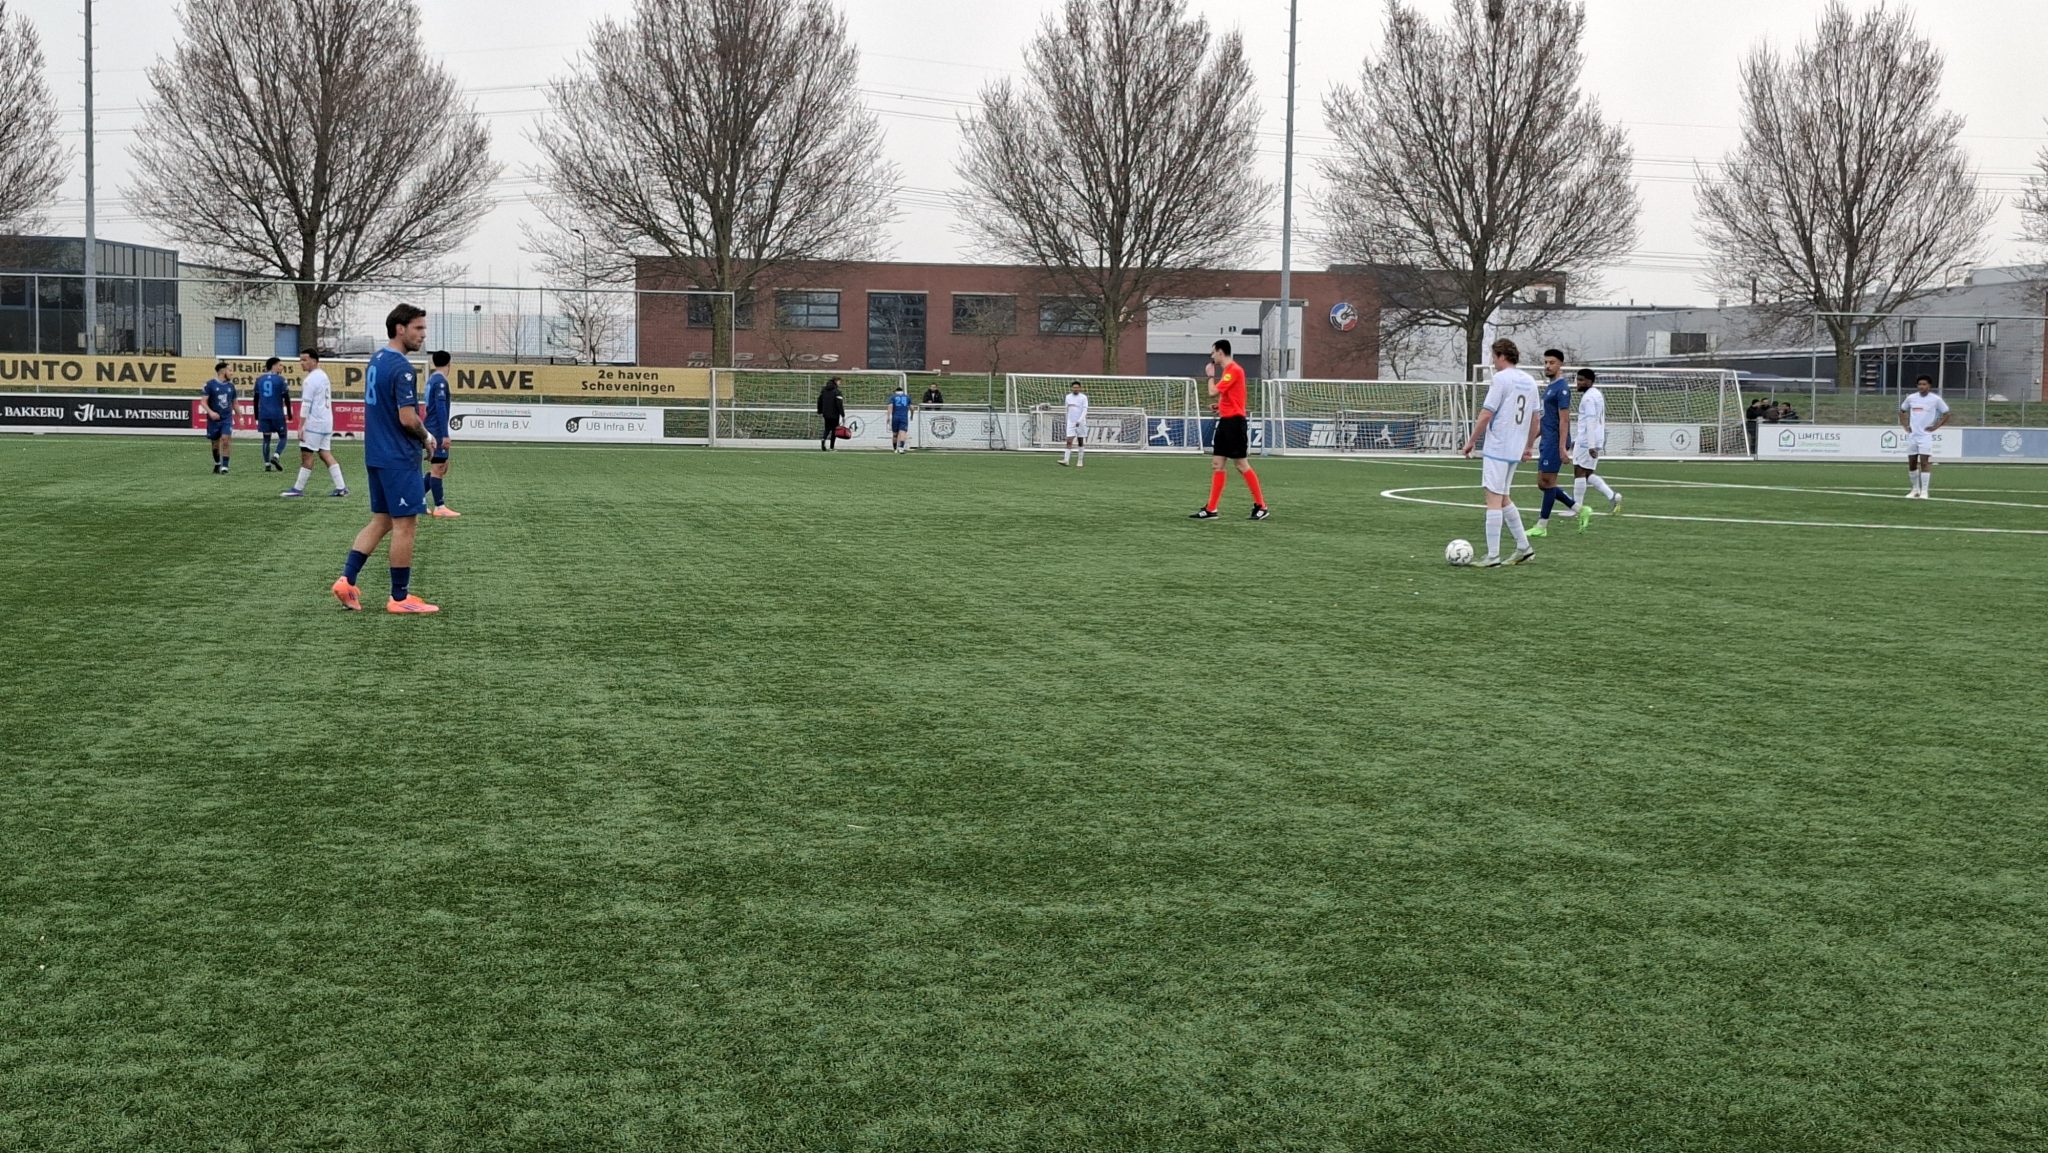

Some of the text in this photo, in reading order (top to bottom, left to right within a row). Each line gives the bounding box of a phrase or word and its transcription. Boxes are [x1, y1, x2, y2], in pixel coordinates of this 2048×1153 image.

[0, 360, 176, 382] UNTO NAVE
[233, 363, 294, 373] Italins
[598, 369, 659, 380] 2e haven
[365, 365, 377, 406] 8
[457, 369, 534, 390] NAVE
[263, 381, 273, 397] 9
[581, 381, 675, 394] Scheveningen
[895, 396, 907, 406] 24
[4, 406, 65, 419] BAKKERIJ
[74, 403, 123, 421] HILAL
[125, 409, 189, 420] PATISSERIE
[1515, 394, 1526, 425] 3
[470, 420, 485, 429] UB
[488, 421, 509, 429] Infra
[586, 422, 646, 431] UB Infra B.V.
[1797, 433, 1841, 441] LIMITLESS
